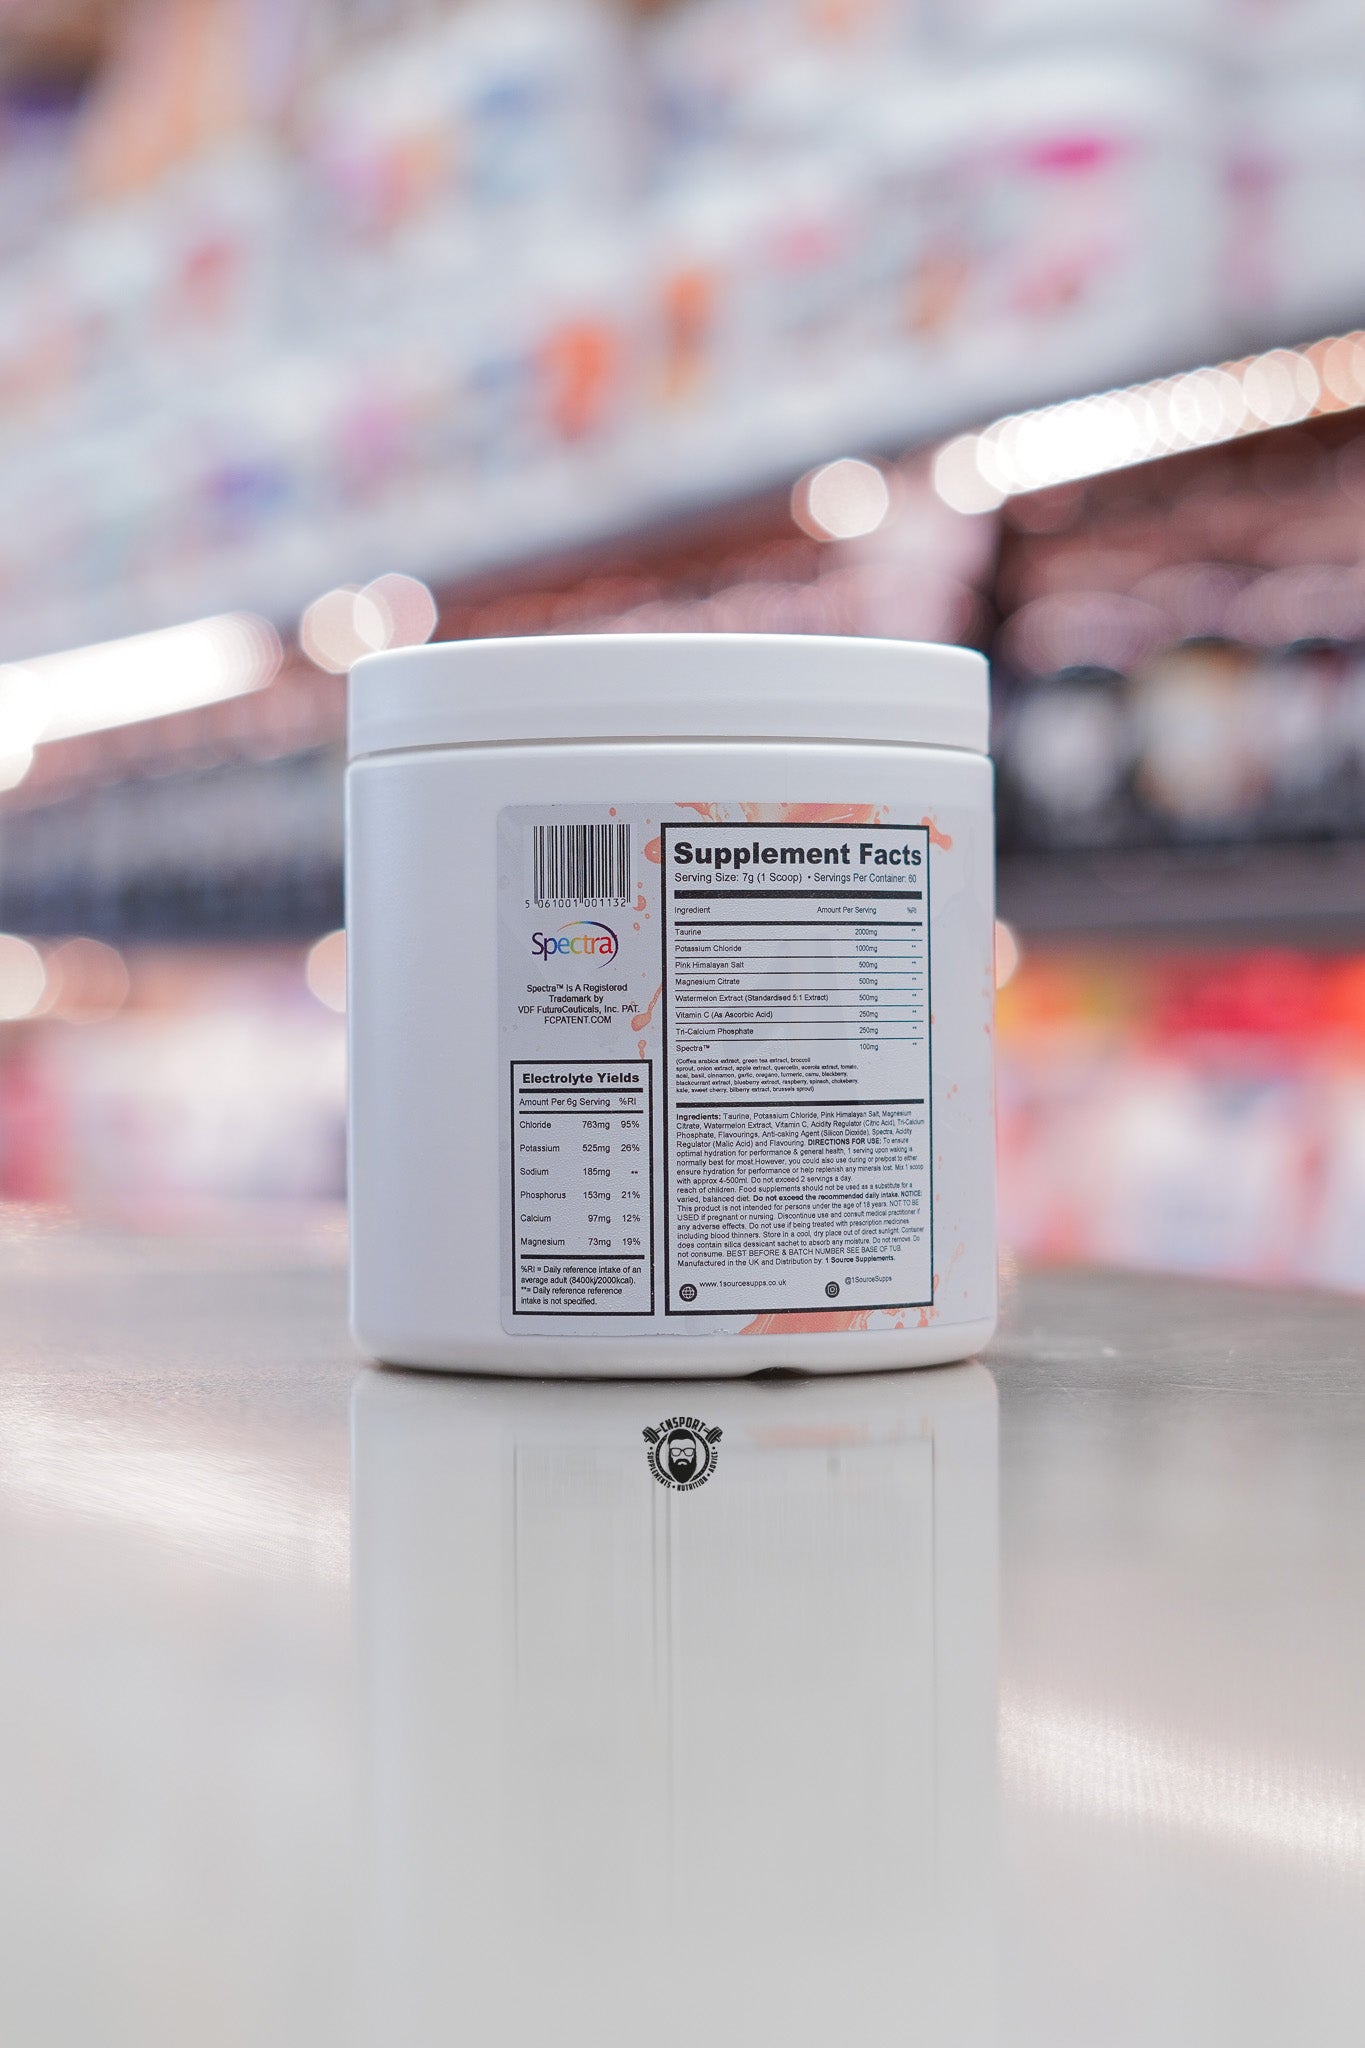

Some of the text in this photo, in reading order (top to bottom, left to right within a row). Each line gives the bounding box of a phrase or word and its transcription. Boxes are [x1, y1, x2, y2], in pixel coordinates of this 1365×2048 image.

[674, 842, 921, 869] Supplement Facts
[675, 873, 711, 884] Serving
[716, 873, 738, 882] Size:
[743, 873, 753, 884] 7g
[757, 873, 765, 884] (1
[770, 873, 802, 884] Scoop)
[814, 873, 850, 884] Servings
[853, 873, 867, 882] Per
[908, 874, 917, 883] 60
[525, 898, 626, 908] 5 061001 001132
[675, 907, 711, 915] Ingredient
[855, 907, 877, 915] Serving
[532, 932, 613, 961] Spectra
[856, 945, 877, 953] 1000mg
[693, 962, 728, 970] Himalayan
[859, 961, 878, 969] 500mg
[676, 978, 715, 986] Magnesium
[859, 978, 878, 986] 500mg
[566, 984, 573, 992] Is
[575, 984, 581, 992] A
[583, 984, 628, 993] Registered
[549, 995, 604, 1004] Trademark by
[745, 995, 791, 1003] (Standardised
[859, 994, 878, 1002] 500mg
[518, 1005, 640, 1015] VDF FutureCeuticals, Inc. PAT.
[756, 1011, 773, 1019] Acid)
[545, 1016, 611, 1024] FCPATENT.COM
[676, 1027, 878, 1036] Tri-Calcium Phosphate 250mg
[860, 1043, 879, 1051] 100mg
[523, 1073, 639, 1085] Electrolyte Yields
[519, 1098, 549, 1106] Amount
[551, 1098, 565, 1106] Per
[567, 1098, 577, 1107] 6g
[580, 1098, 610, 1107] Serving
[582, 1121, 610, 1130] 763mg
[621, 1120, 639, 1128] 95%
[520, 1144, 640, 1153] Potassium 525mg 26%
[584, 1168, 610, 1177] 185mg
[521, 1191, 640, 1201] Phosphorus 153mg 21%
[520, 1214, 640, 1224] Calcium 97mg 12%
[521, 1238, 641, 1247] Magnesium 73mg 19%
[544, 1266, 561, 1275] Daily
[563, 1266, 597, 1274] reference
[699, 1279, 786, 1288] www.1sourcesupps.co.uk
[845, 1275, 892, 1285] @1SourceSupps
[533, 1287, 550, 1295] Daily
[564, 1298, 597, 1306] specified.
